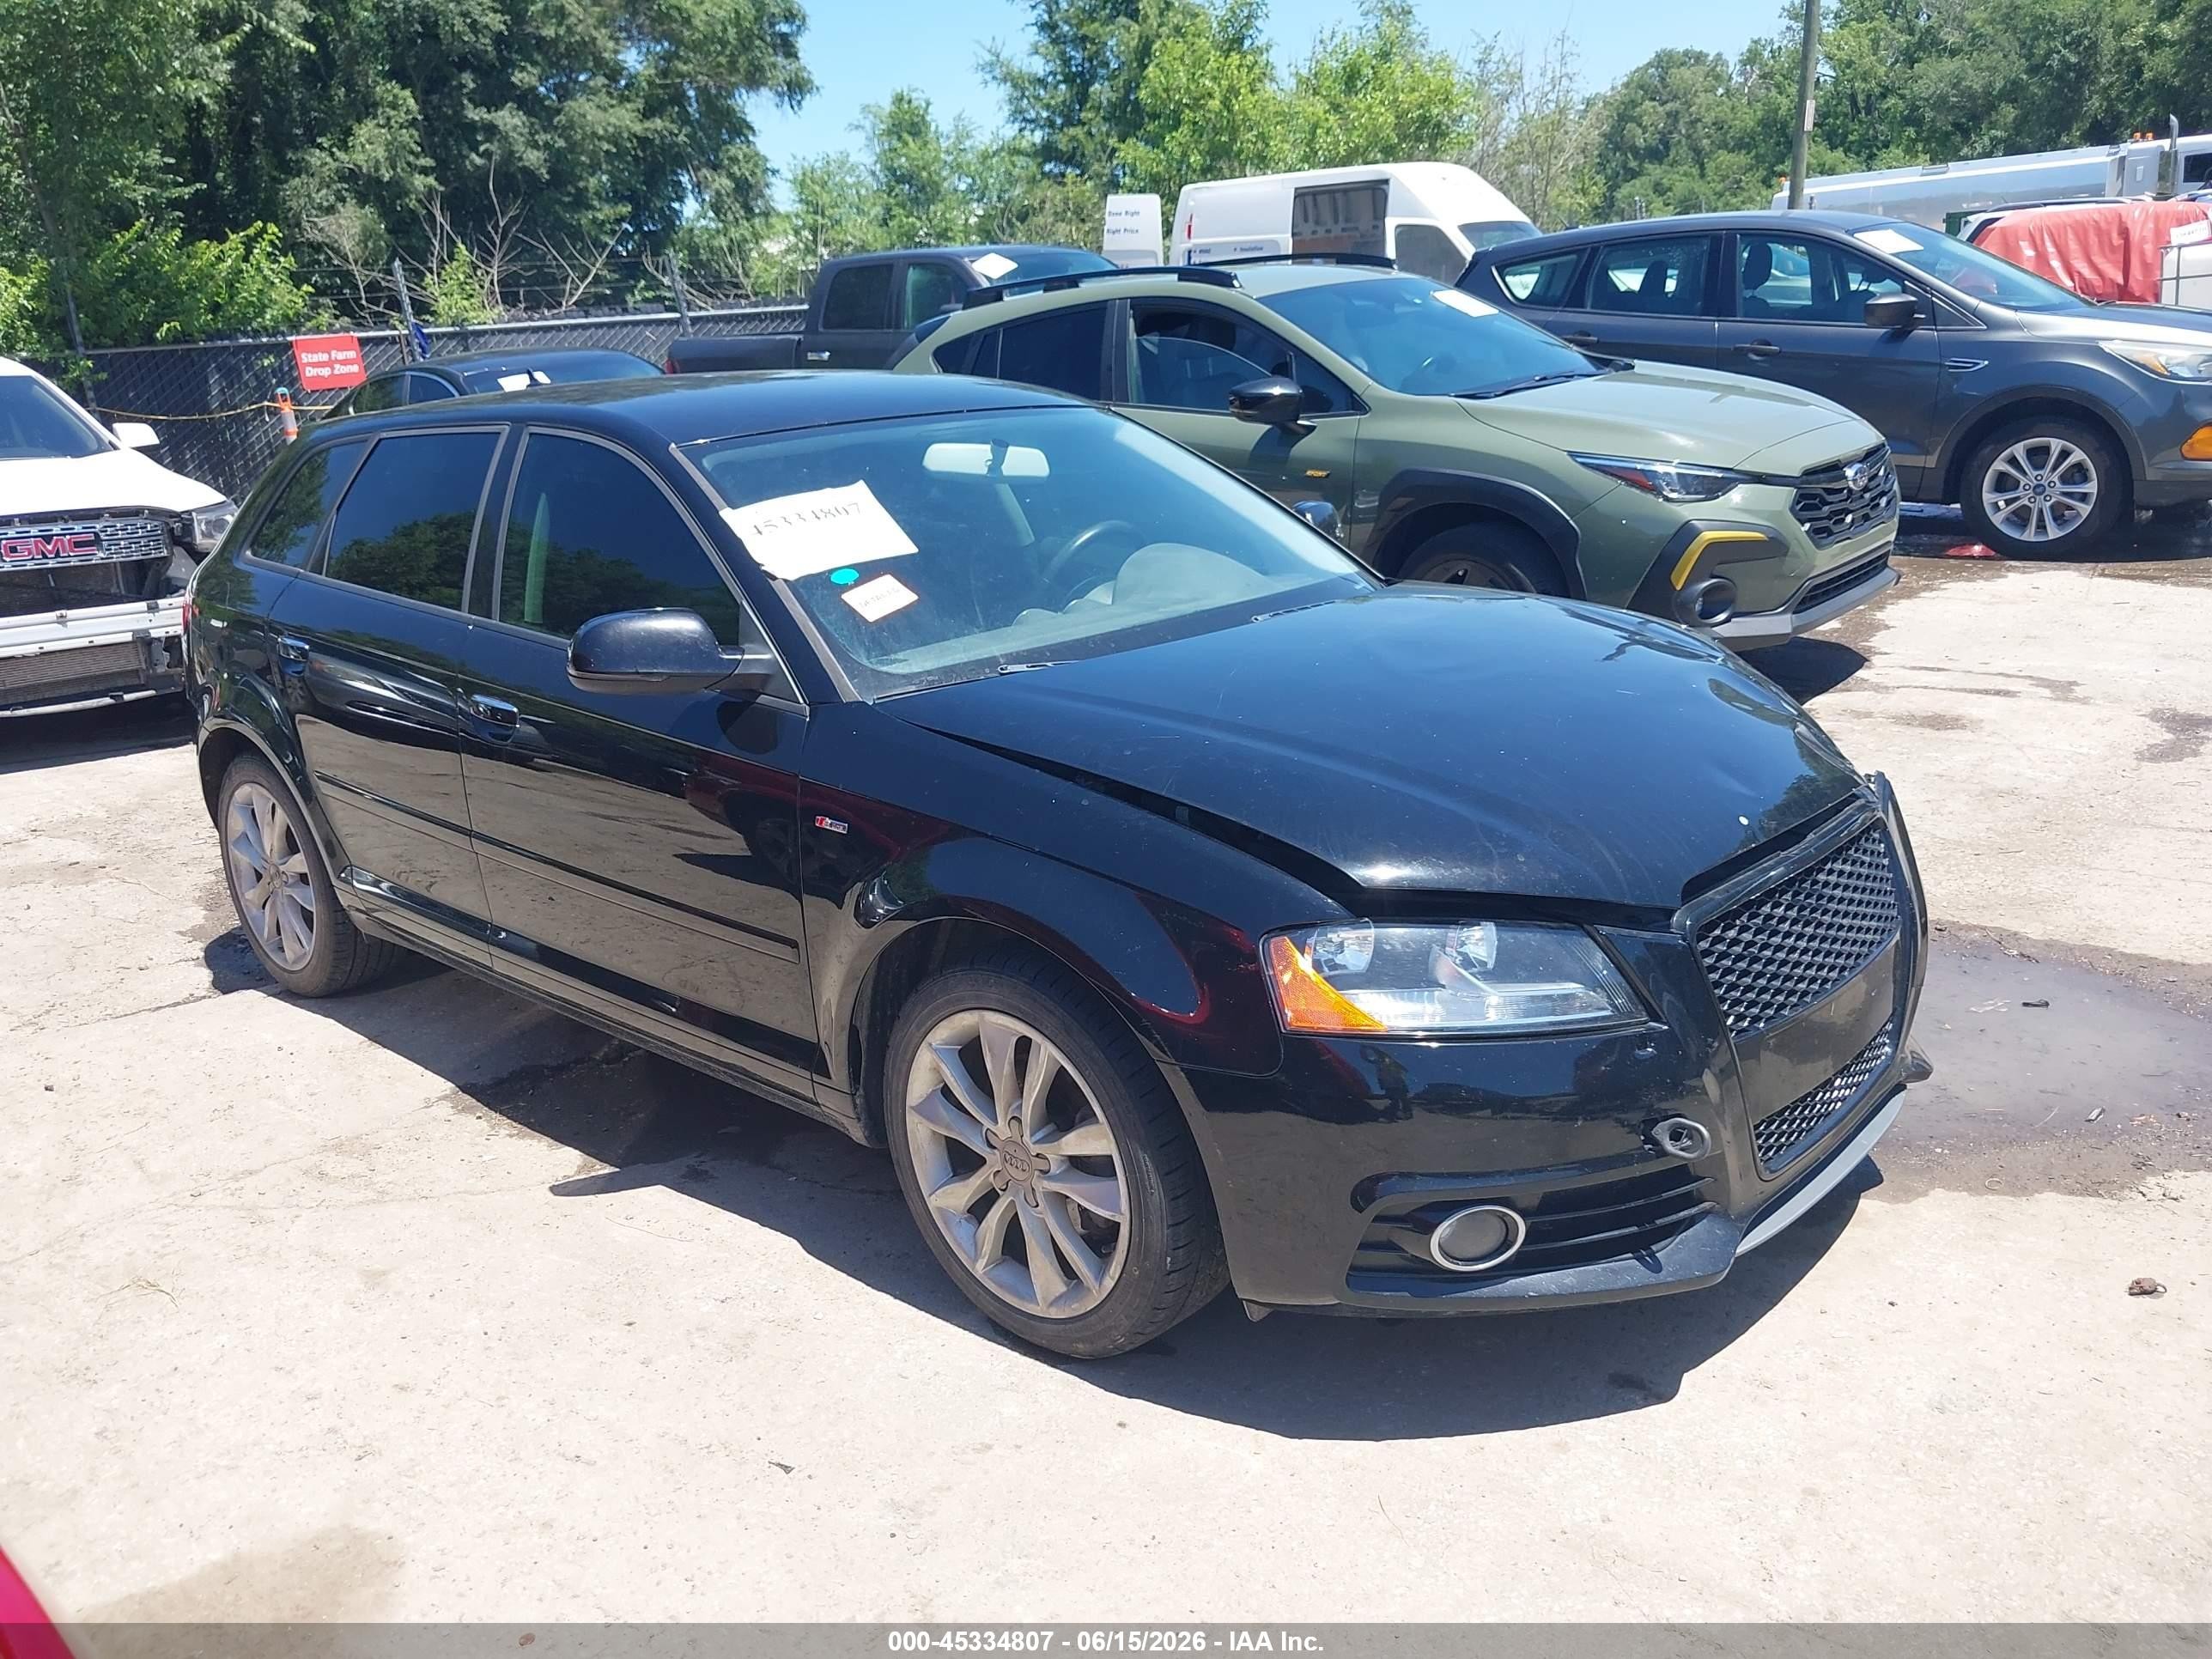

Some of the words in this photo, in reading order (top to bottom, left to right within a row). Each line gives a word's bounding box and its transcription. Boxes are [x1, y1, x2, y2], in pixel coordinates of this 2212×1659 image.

[301, 352, 330, 362] State
[331, 350, 356, 360] Farm
[306, 367, 331, 377] Drop
[333, 364, 359, 374] Zone
[1, 534, 97, 561] GMC
